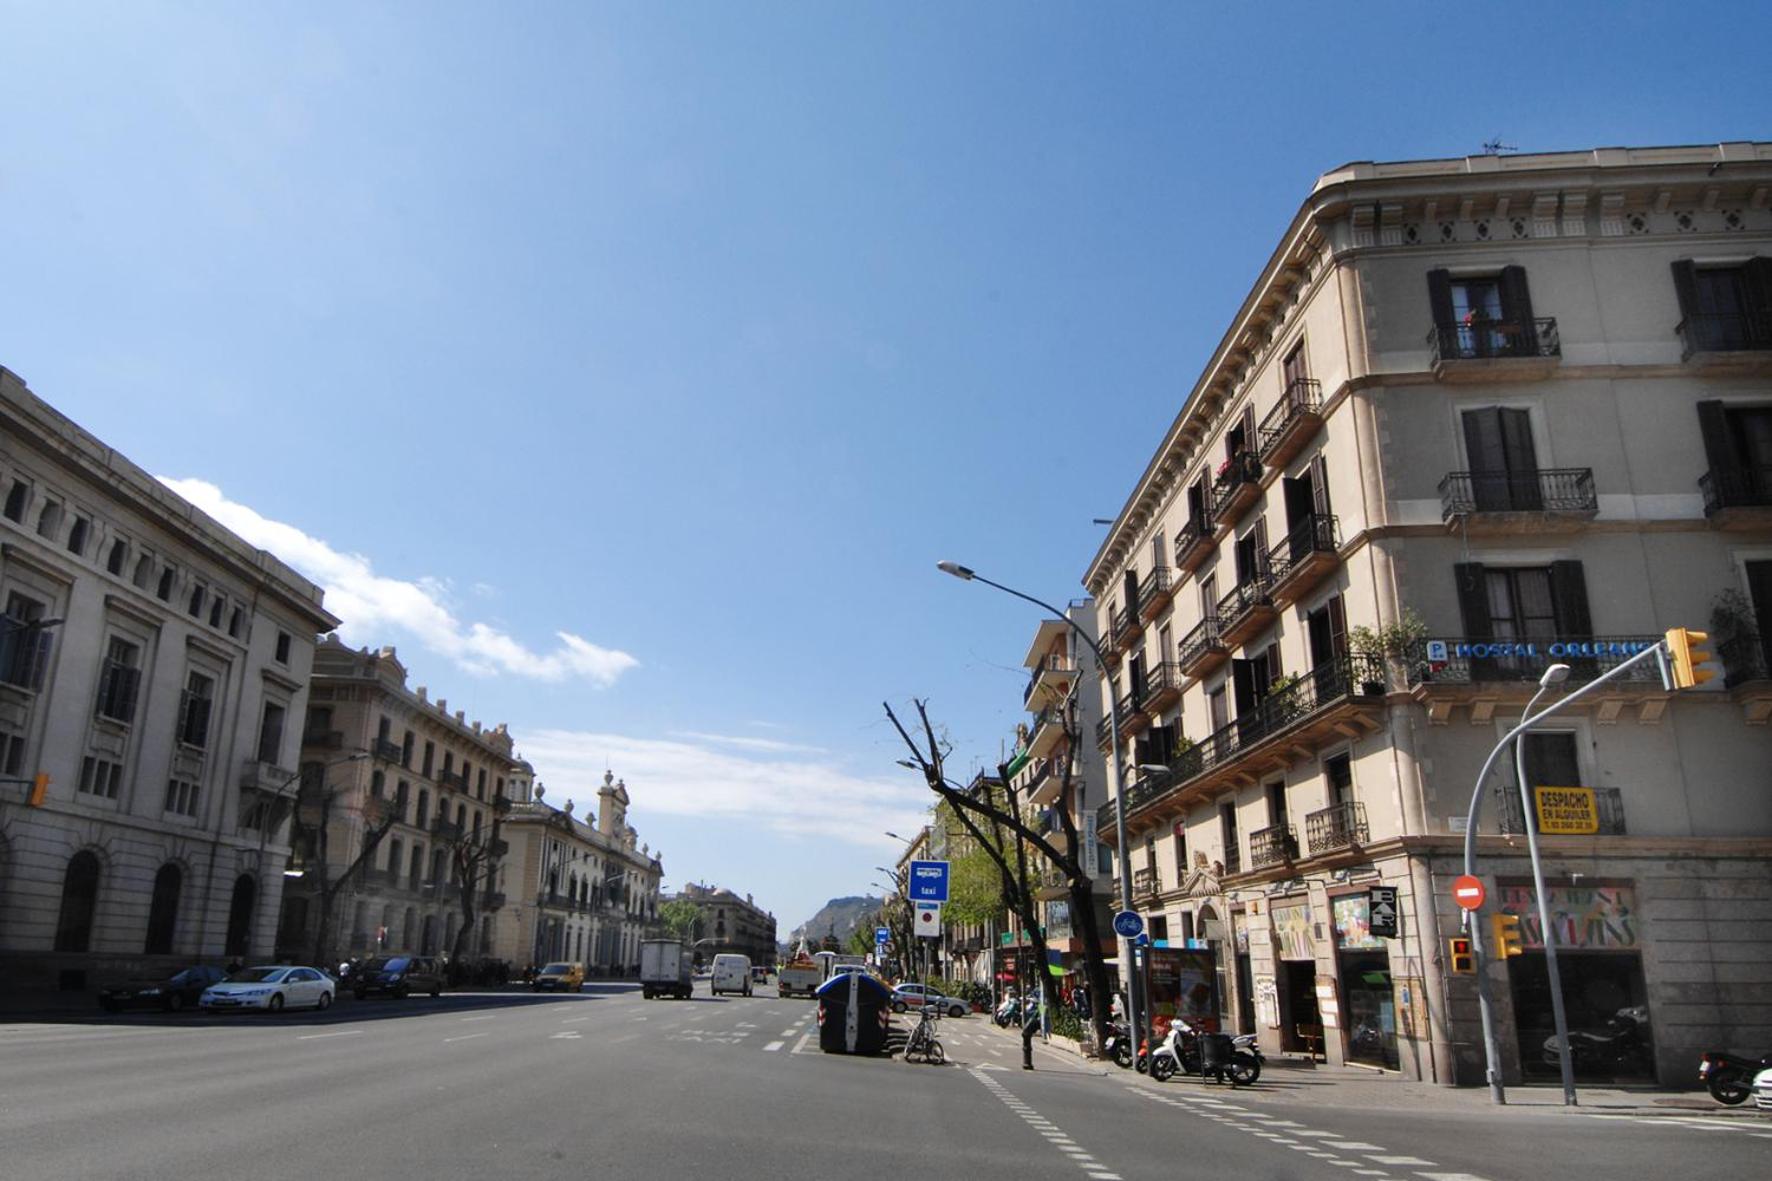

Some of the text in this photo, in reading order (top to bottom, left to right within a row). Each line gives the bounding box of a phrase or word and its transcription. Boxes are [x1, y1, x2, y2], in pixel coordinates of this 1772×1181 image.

[1455, 641, 1538, 658] HOSTAL
[1541, 791, 1590, 808] DESPACHO
[921, 886, 937, 895] taxi
[1371, 890, 1396, 926] BAR
